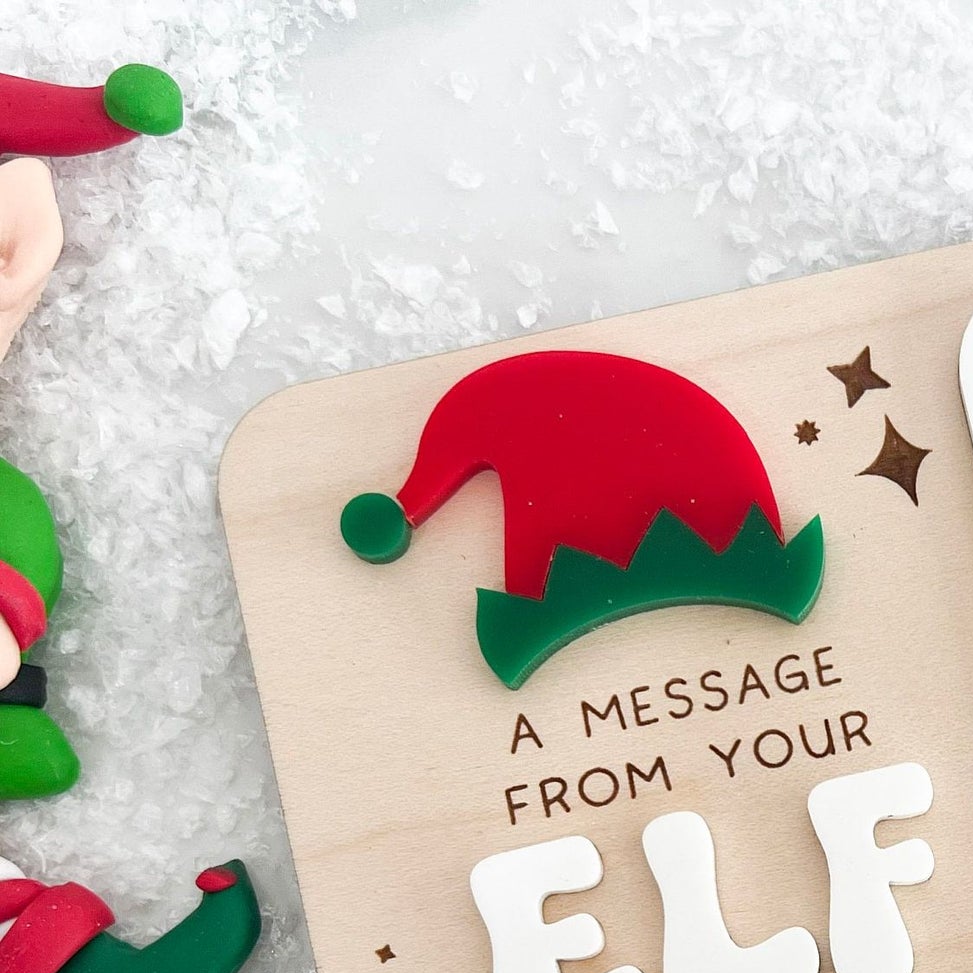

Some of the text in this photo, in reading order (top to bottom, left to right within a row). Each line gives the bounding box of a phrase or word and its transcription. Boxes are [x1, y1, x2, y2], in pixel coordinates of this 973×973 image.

[511, 646, 842, 754] A MESSAGE
[504, 710, 872, 825] FROM YOUR
